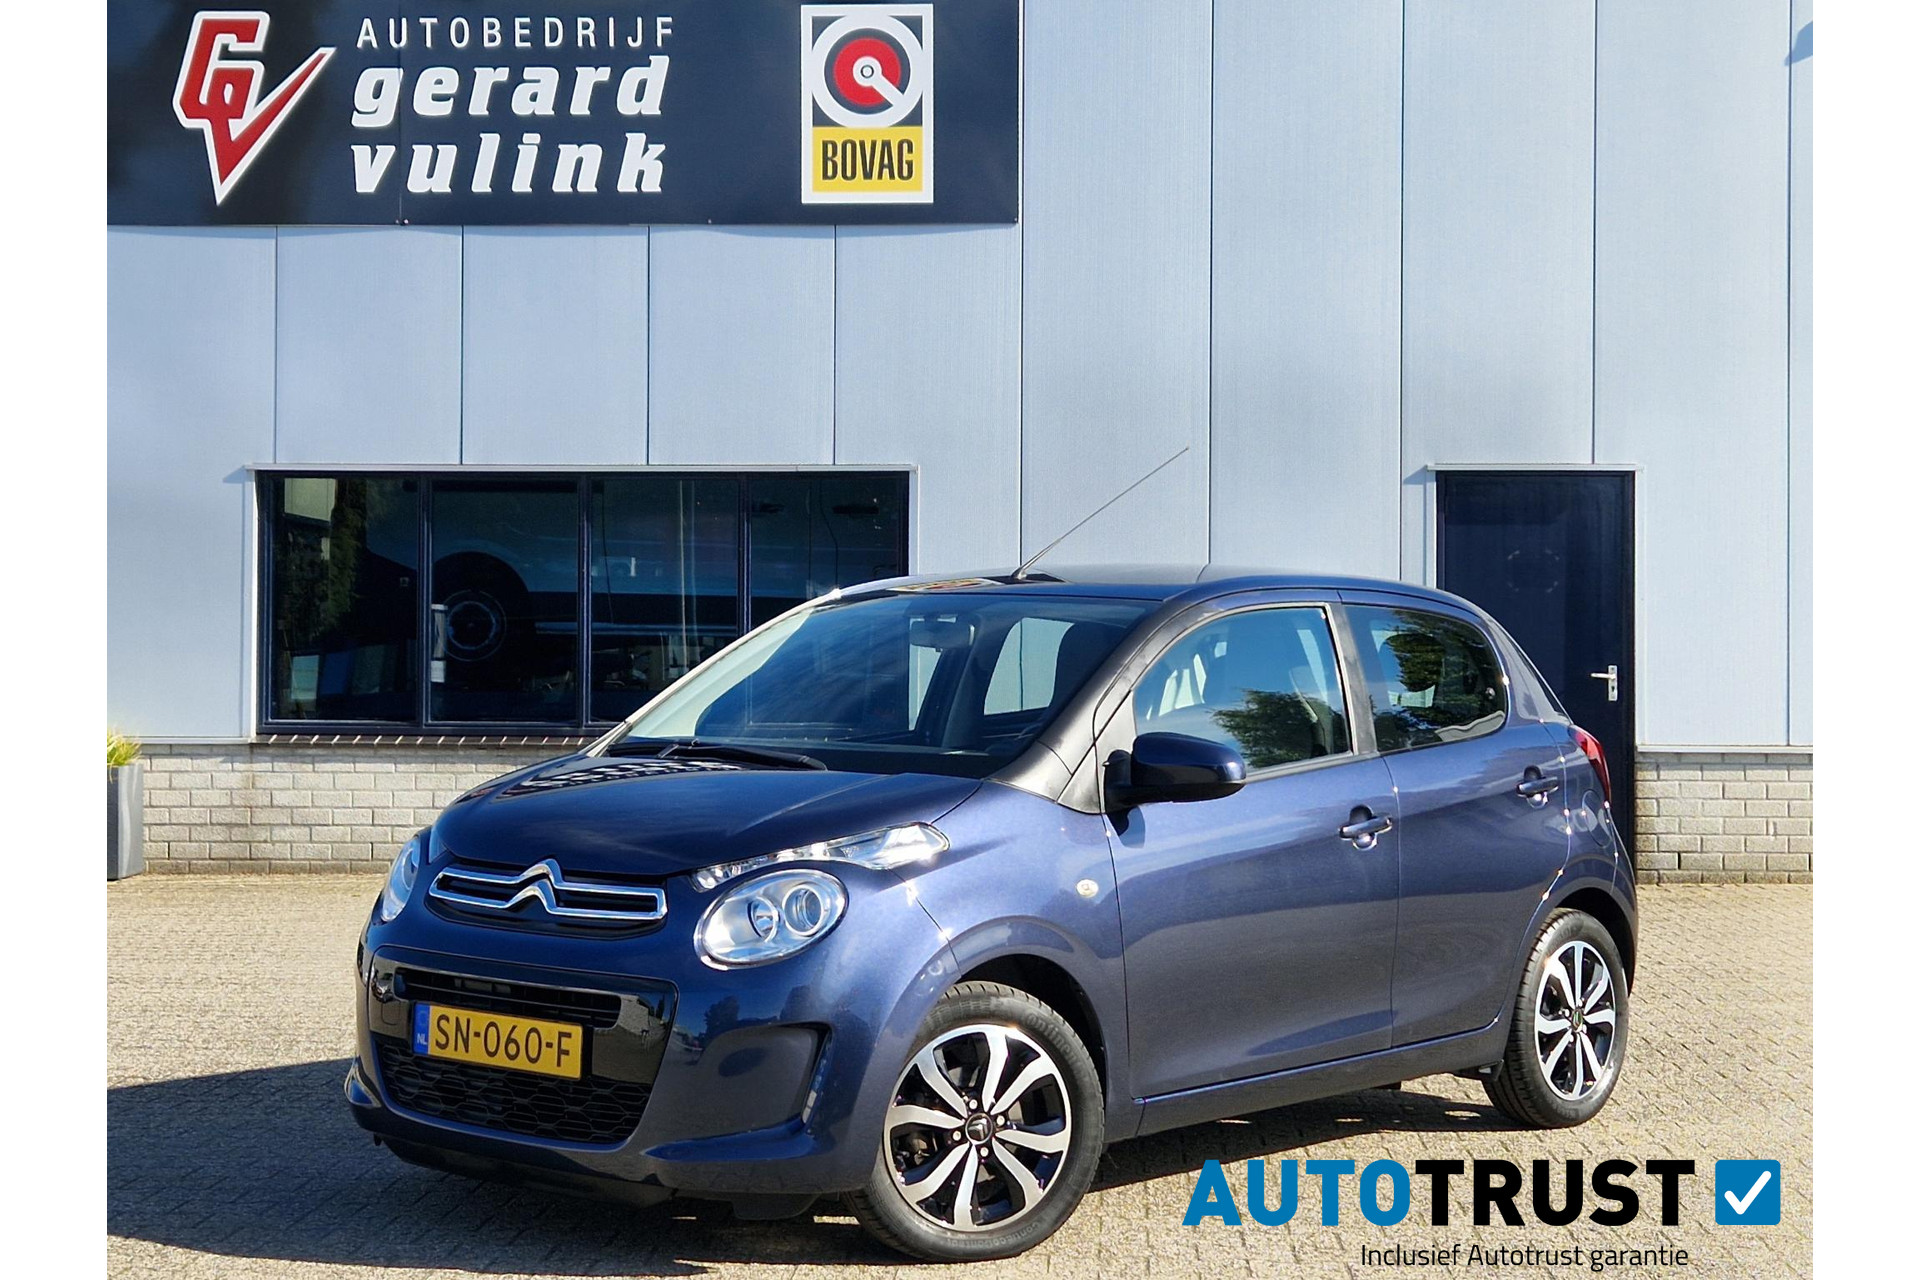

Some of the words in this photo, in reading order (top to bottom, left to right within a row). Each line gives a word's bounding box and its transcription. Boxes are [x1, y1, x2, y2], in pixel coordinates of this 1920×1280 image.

[357, 16, 675, 49] AUTOBEDRIJF
[351, 55, 670, 126] gerard
[350, 132, 667, 193] vulink
[821, 138, 915, 182] BOVAG
[416, 1033, 428, 1046] NL
[435, 1013, 573, 1068] SN-060-F
